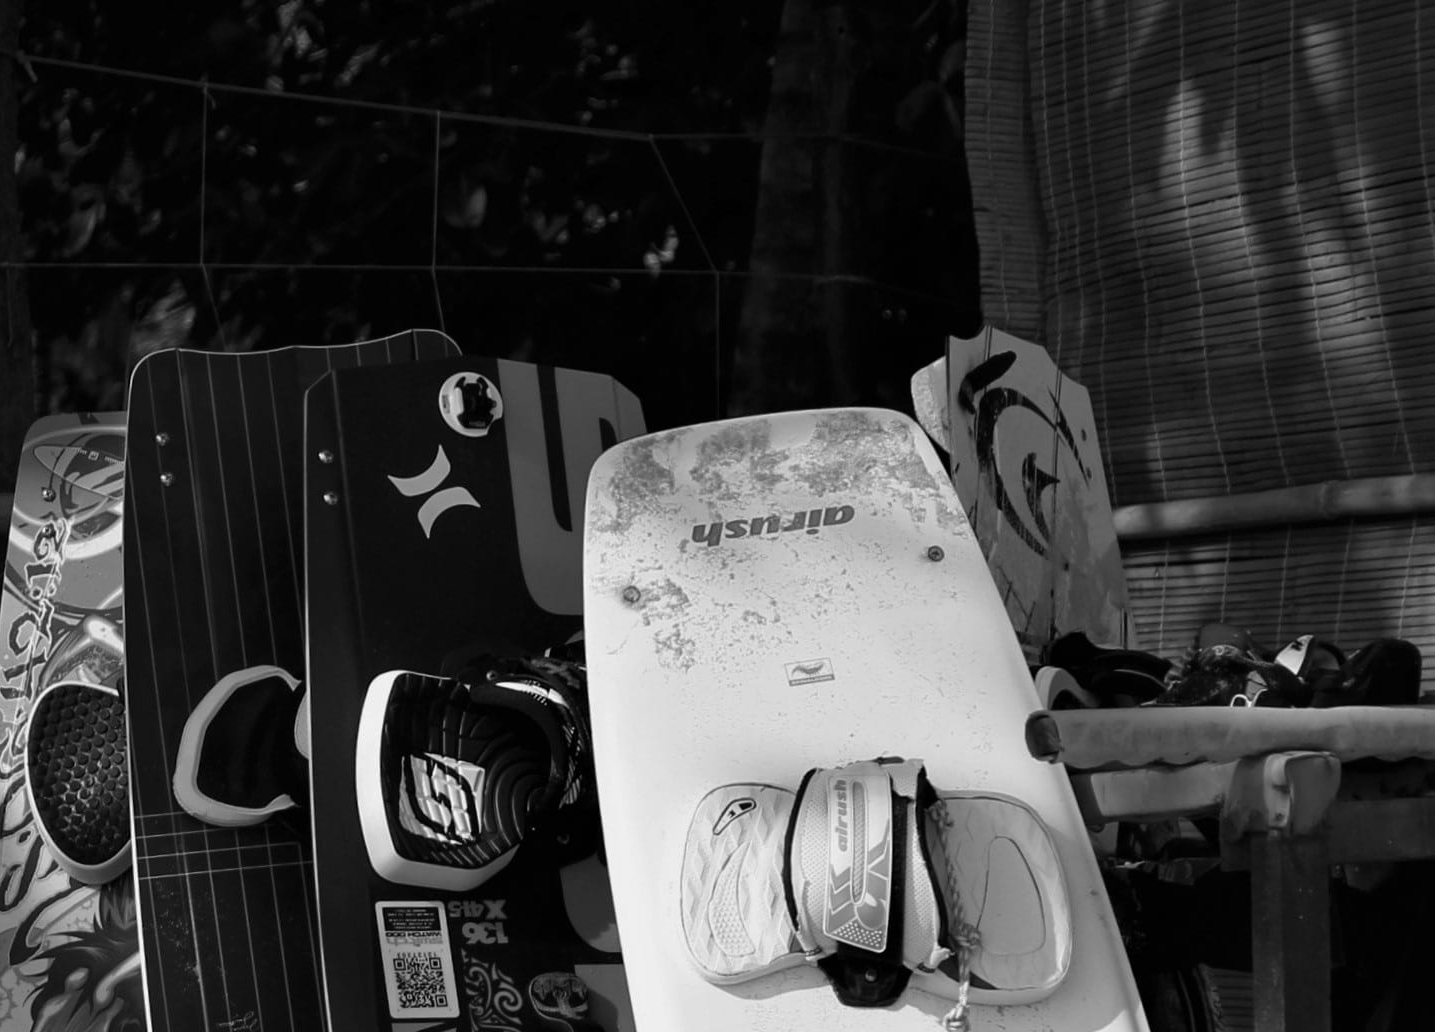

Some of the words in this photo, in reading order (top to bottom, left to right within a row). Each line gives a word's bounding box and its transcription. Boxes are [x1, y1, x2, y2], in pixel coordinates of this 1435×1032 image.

[692, 504, 855, 546] airush
[833, 778, 848, 852] airush
[462, 922, 508, 944] 136
